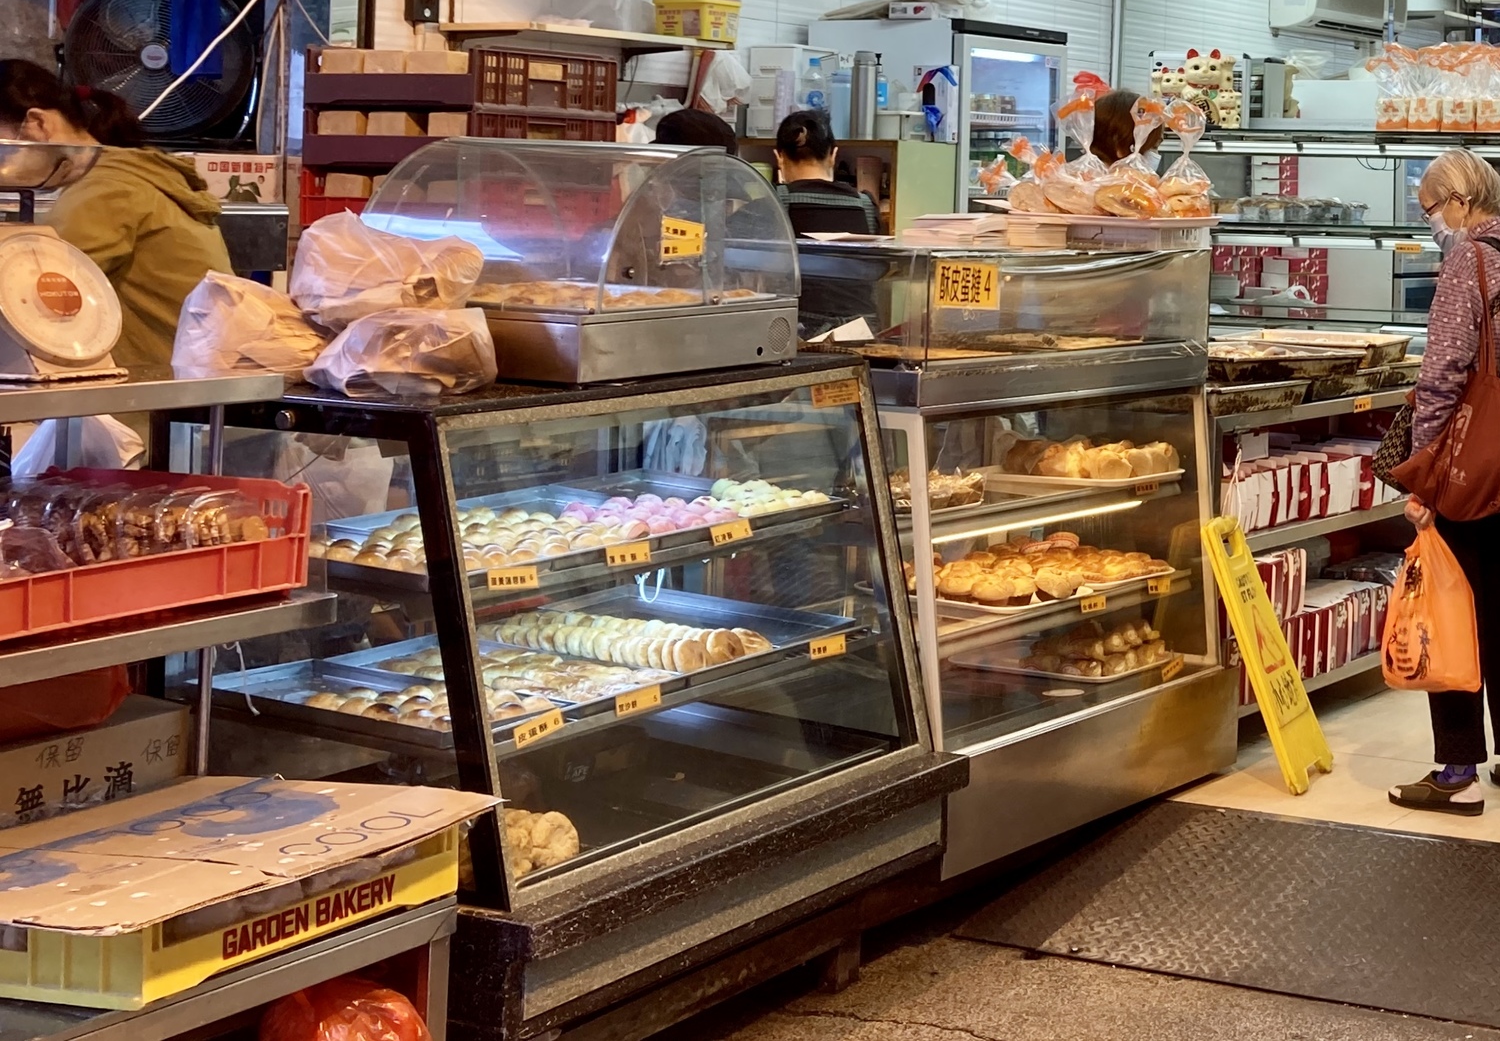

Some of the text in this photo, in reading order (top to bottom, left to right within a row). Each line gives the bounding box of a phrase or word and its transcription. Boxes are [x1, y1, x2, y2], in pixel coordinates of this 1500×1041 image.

[939, 265, 992, 304] 酥皮蛋撻 4
[518, 717, 560, 744] 皮蛋酥 6
[36, 736, 85, 769] 保留
[279, 808, 443, 856] COOL
[222, 874, 396, 961] GARDEN BAKERY
